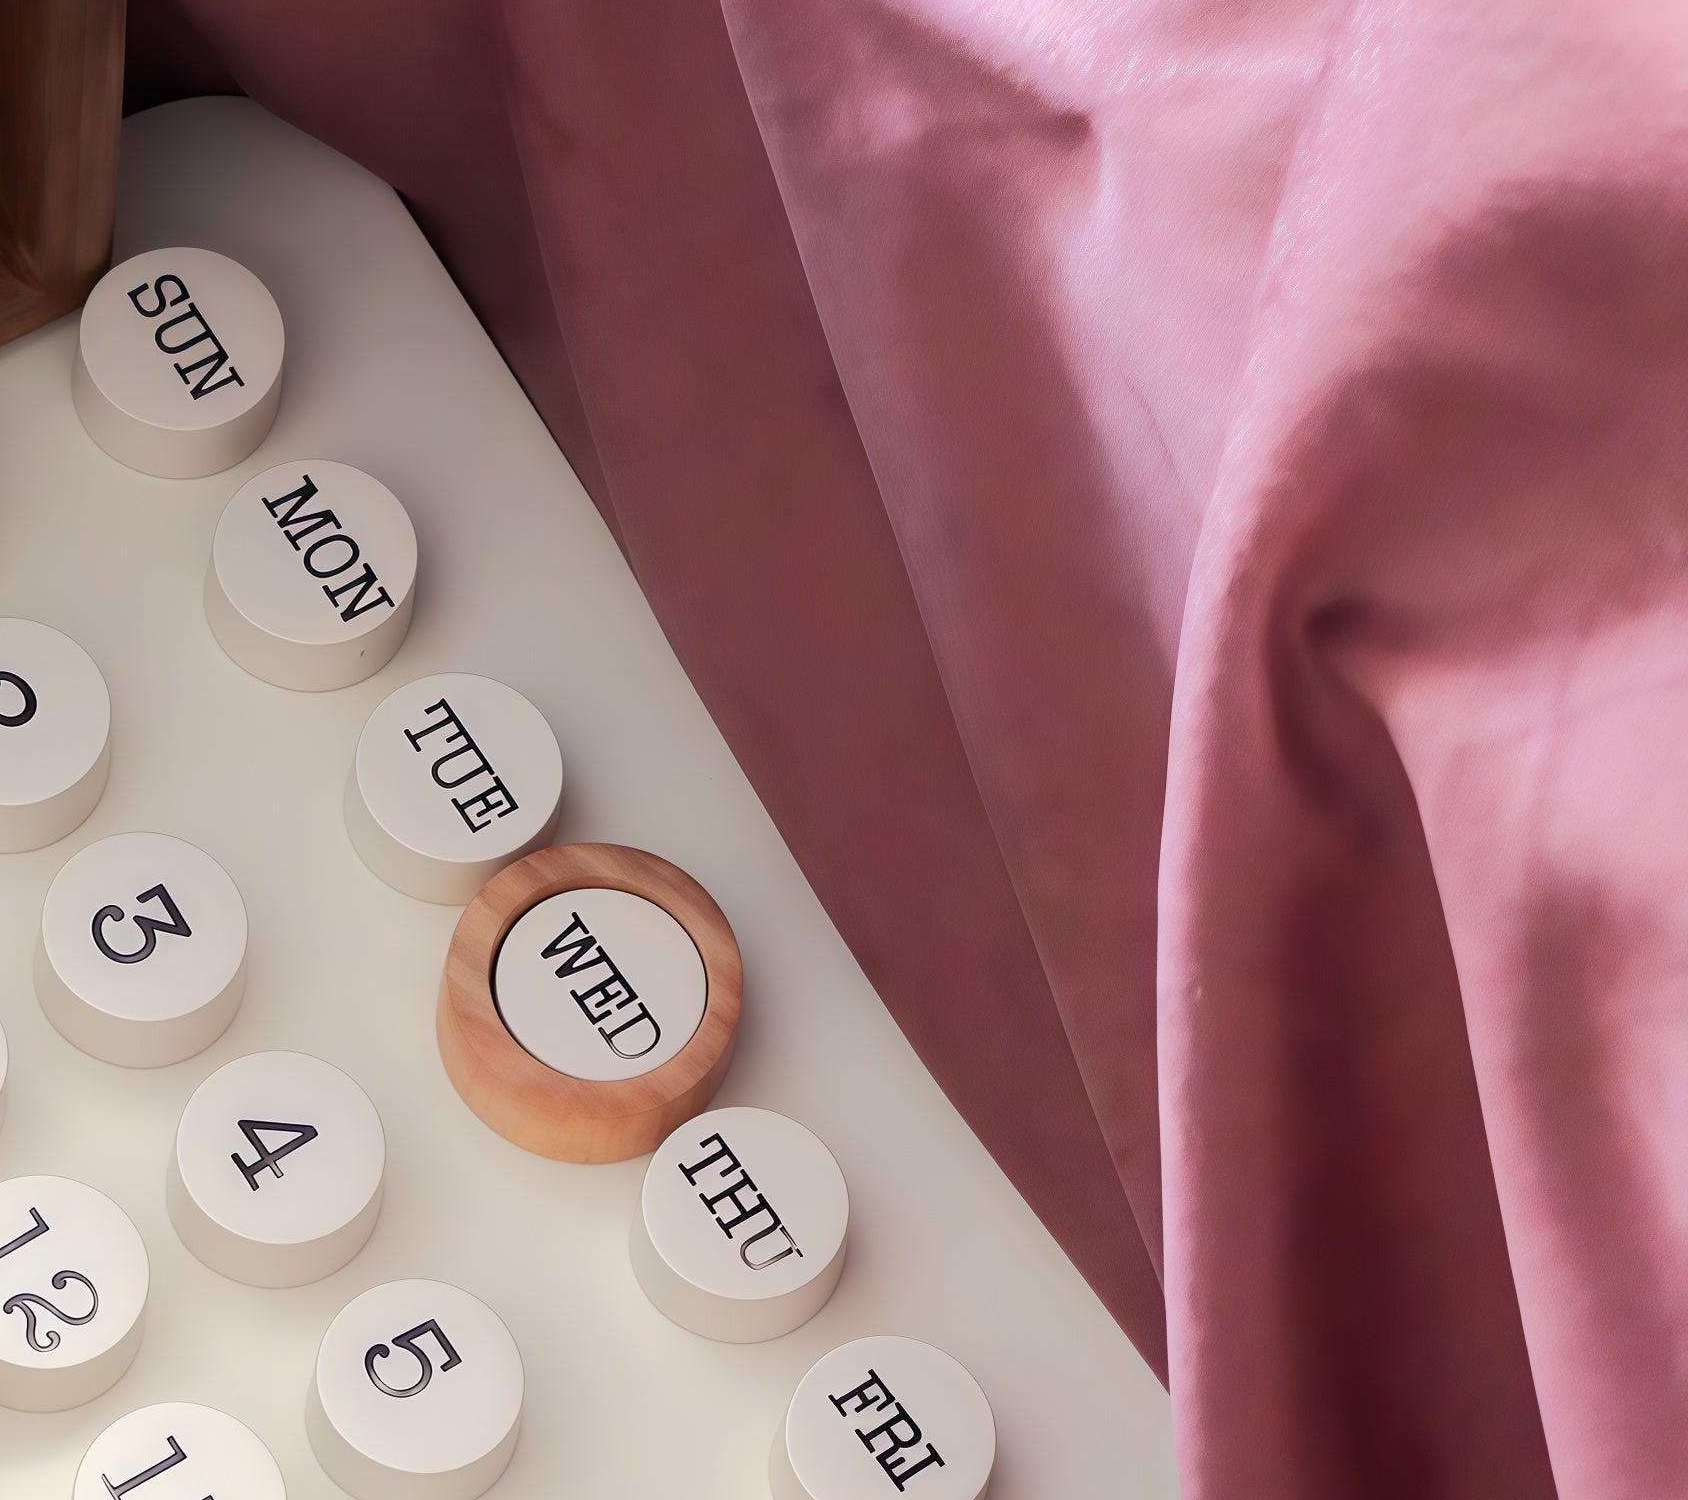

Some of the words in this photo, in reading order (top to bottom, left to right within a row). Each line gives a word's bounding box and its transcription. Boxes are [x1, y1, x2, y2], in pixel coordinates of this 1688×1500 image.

[127, 272, 245, 401] SUN
[261, 473, 396, 623] MON
[403, 698, 519, 834] TUE
[91, 883, 193, 965] 3
[540, 911, 662, 1060] WED
[230, 1119, 319, 1192] 4
[678, 1132, 805, 1271] THU
[363, 1318, 463, 1399] 5
[827, 1368, 946, 1493] FRI
